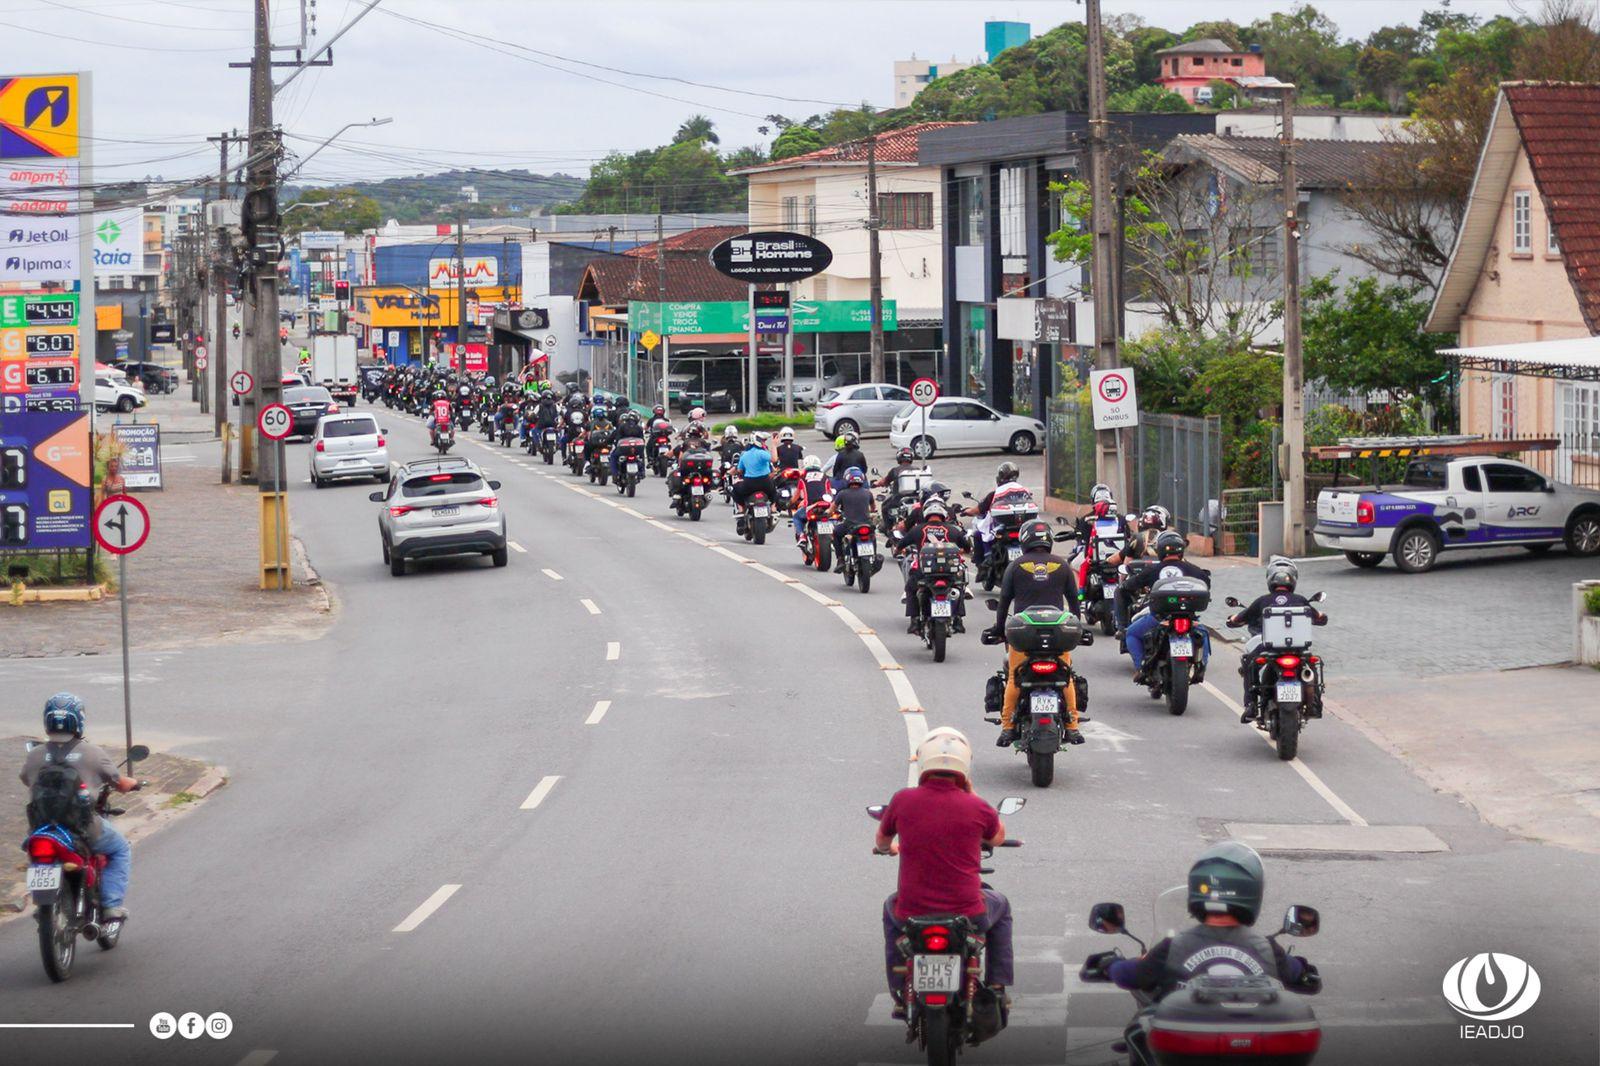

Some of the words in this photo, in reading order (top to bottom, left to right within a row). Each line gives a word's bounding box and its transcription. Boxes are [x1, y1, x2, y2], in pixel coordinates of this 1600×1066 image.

[9, 171, 54, 184] ampm
[756, 240, 795, 250] Brasil
[756, 250, 813, 259] Homens
[23, 259, 71, 273] Ipimax
[3, 298, 17, 318] E
[36, 304, 72, 319] 4,44
[668, 325, 703, 333] FINANCIA
[4, 331, 20, 350] G
[36, 335, 72, 351] 6,07
[4, 364, 21, 384] G
[37, 367, 73, 383] 6,17
[914, 384, 933, 396] 60
[264, 410, 287, 425] 60
[437, 406, 448, 417] 10
[1102, 413, 1129, 422] ÔNIBUS
[117, 428, 155, 436] PROMOÇÃO
